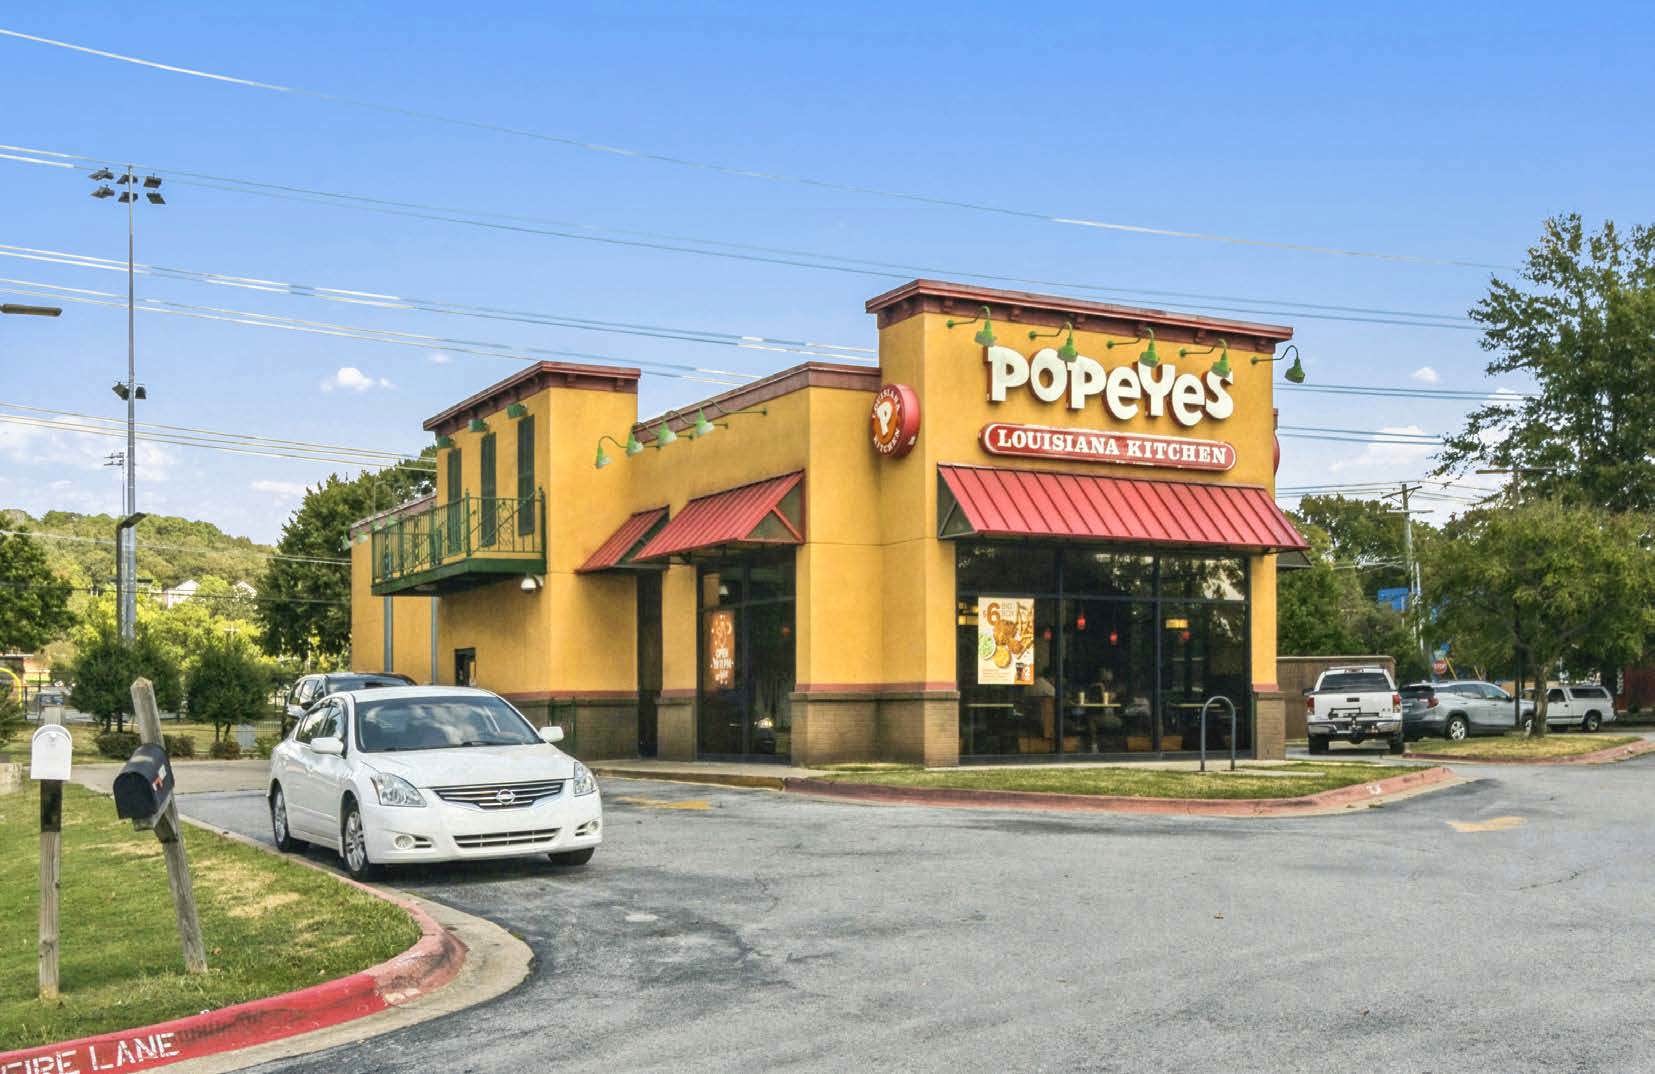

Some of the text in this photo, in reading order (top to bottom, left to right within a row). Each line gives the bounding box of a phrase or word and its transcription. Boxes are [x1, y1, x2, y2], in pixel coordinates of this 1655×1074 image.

[998, 429, 1226, 465] LOUISIANA KITCHEN
[90, 1032, 179, 1070] LANE
